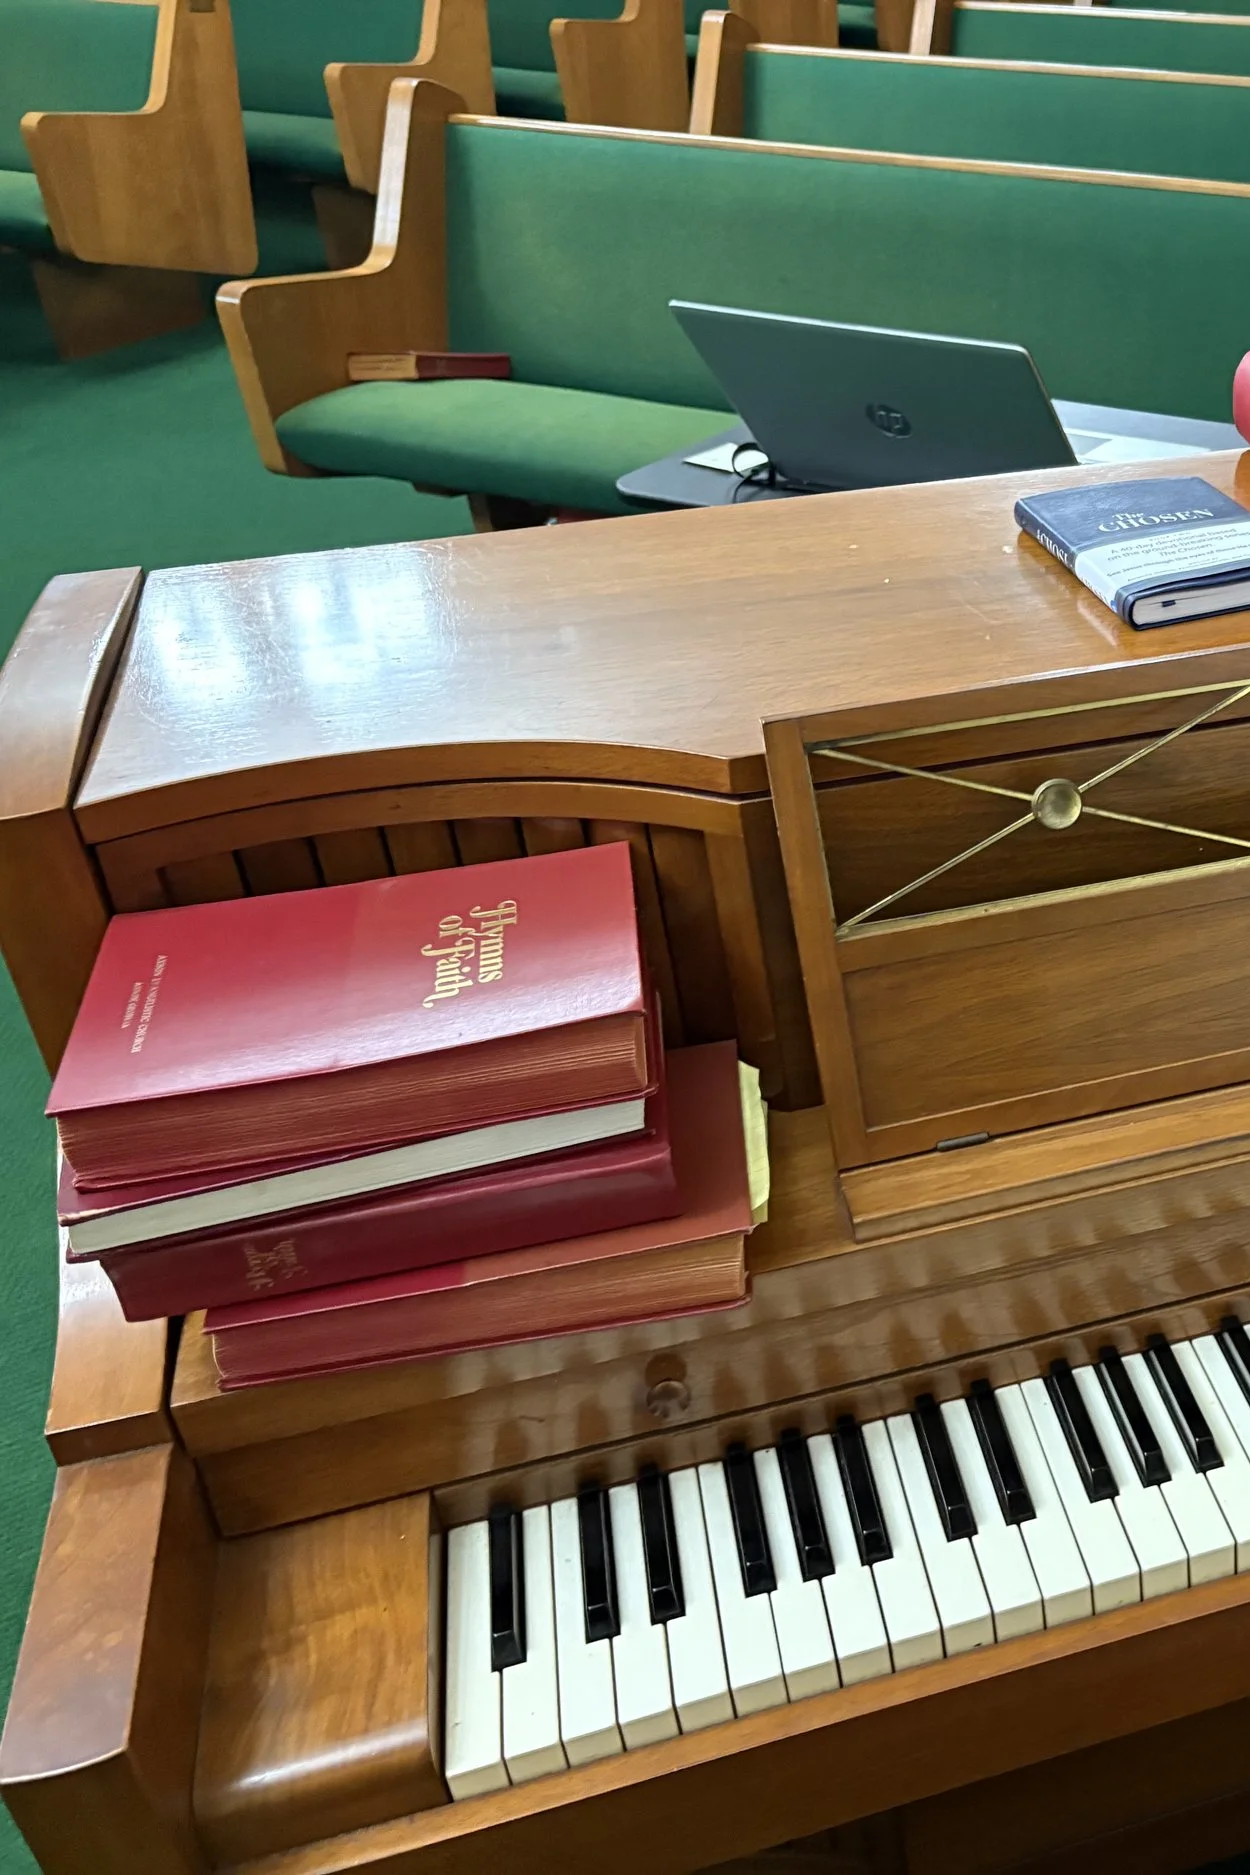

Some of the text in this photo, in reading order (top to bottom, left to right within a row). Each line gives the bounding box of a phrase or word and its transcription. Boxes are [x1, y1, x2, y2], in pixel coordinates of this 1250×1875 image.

[1098, 508, 1214, 532] CHOSEN
[1112, 511, 1144, 523] The
[439, 915, 476, 939] of
[469, 900, 518, 983] Hymns
[421, 937, 476, 1009] Faith
